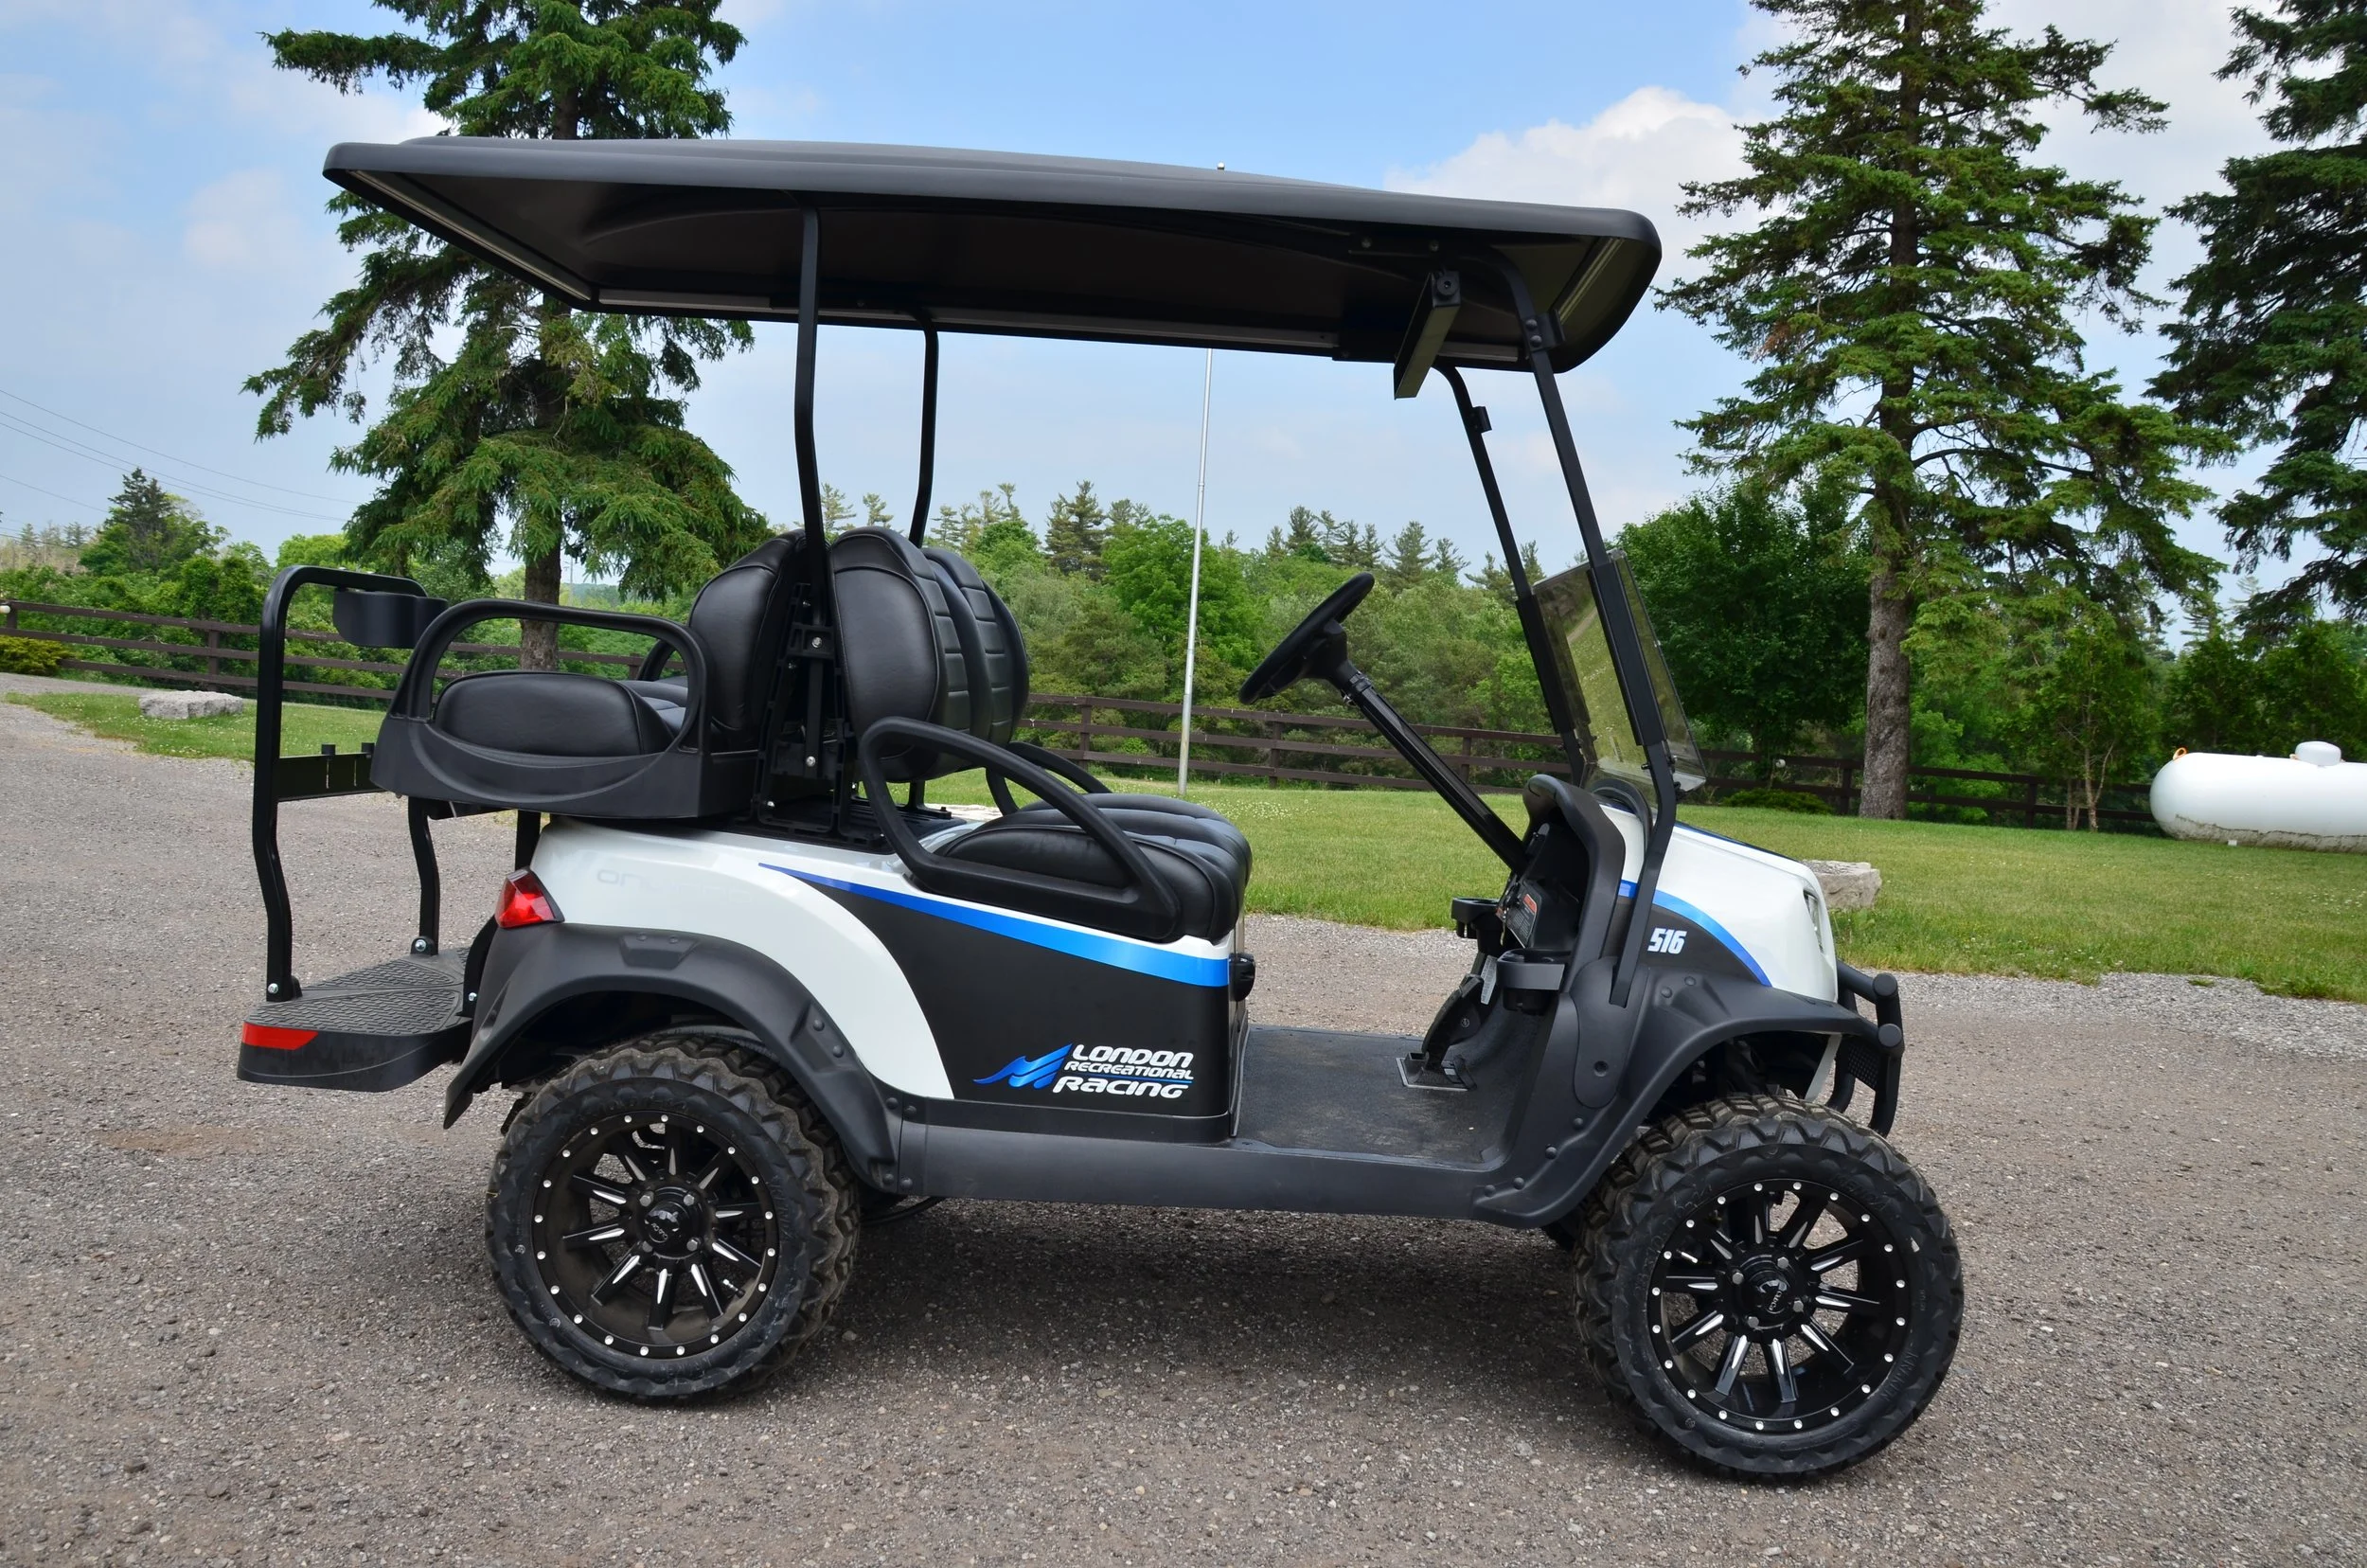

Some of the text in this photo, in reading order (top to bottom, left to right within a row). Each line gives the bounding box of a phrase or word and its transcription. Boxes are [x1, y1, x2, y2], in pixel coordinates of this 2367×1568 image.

[1647, 927, 1687, 954] 516
[1071, 1043, 1194, 1068] LONDON
[1063, 1060, 1194, 1080] RECREATIONAL
[1052, 1076, 1189, 1099] RACING
